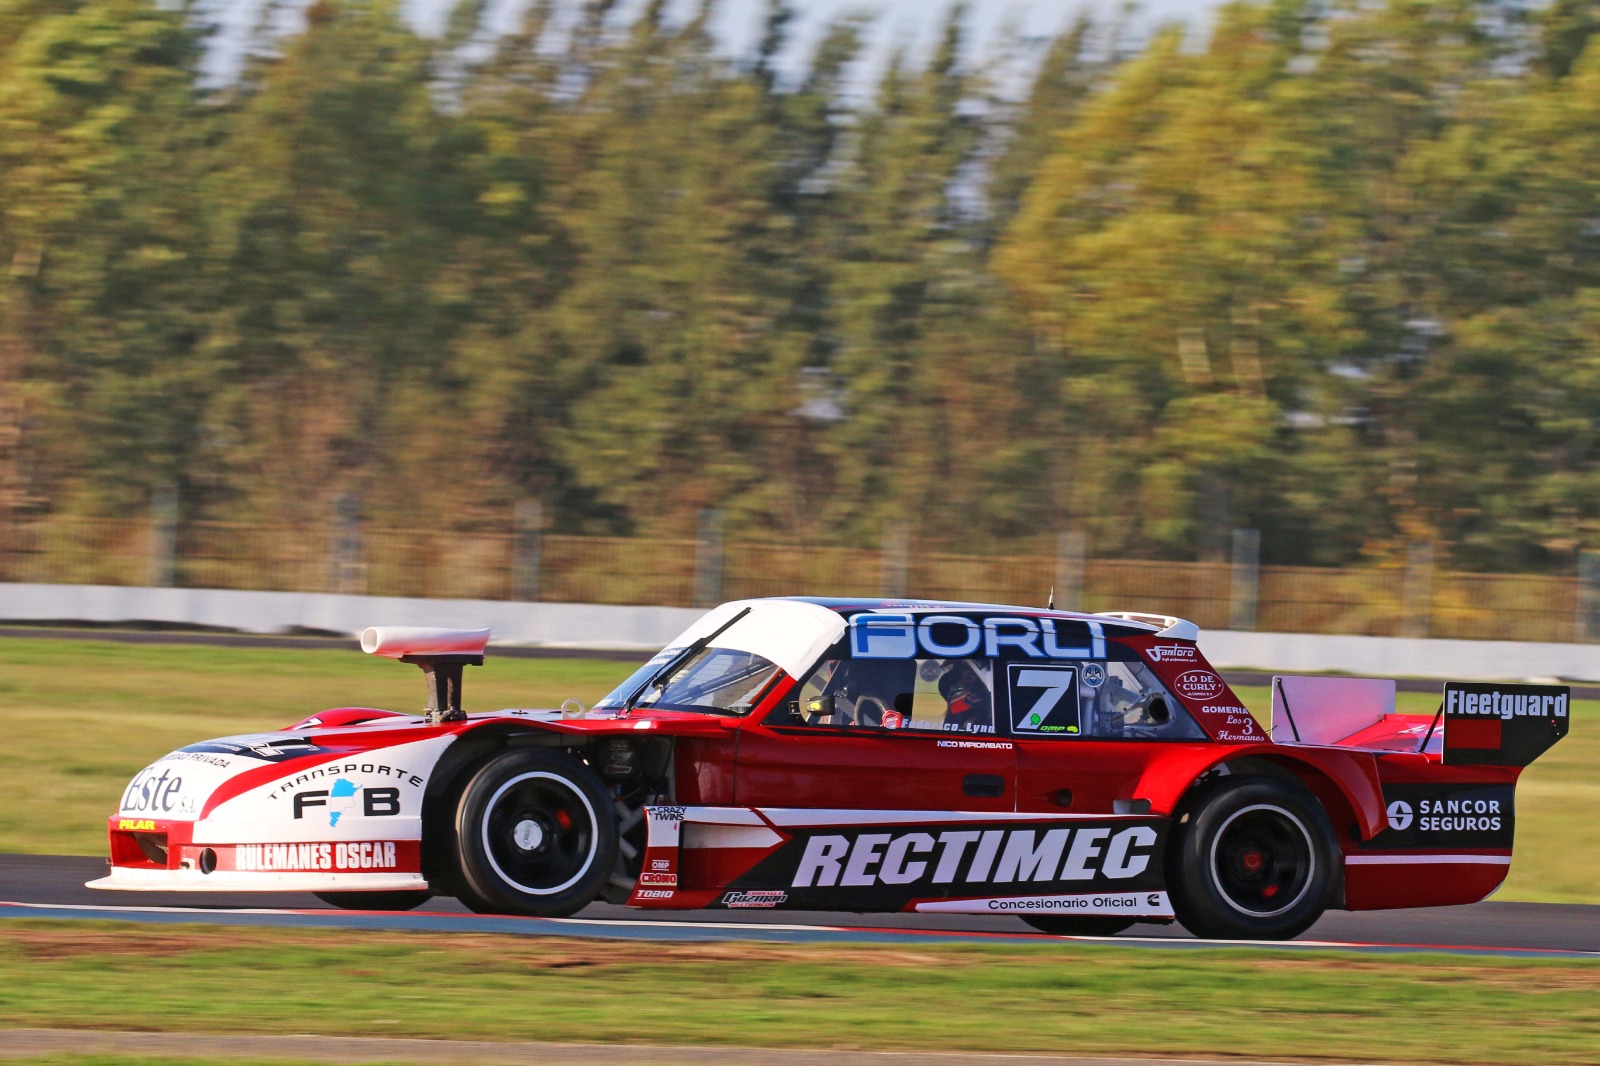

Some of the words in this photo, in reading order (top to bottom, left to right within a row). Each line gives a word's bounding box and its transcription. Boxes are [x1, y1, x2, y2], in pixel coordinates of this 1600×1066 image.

[849, 612, 1107, 660] FORLI
[1146, 643, 1196, 662] Santoro
[1183, 675, 1197, 683] LO
[1200, 675, 1215, 683] DE
[1183, 683, 1216, 691] CURLY
[1016, 669, 1073, 729] 7
[1446, 689, 1568, 720] Fleetguard
[1202, 706, 1249, 715] GOMERIA
[1226, 714, 1242, 724] Los
[1242, 717, 1253, 735] 3
[1216, 730, 1265, 741] Hermanos
[191, 753, 230, 769] PRIVADA
[121, 766, 182, 813] Este
[267, 764, 424, 800] TRANSPORTE
[294, 790, 329, 819] F
[363, 787, 401, 816] B
[657, 806, 687, 814] CRAZY
[1420, 800, 1501, 814] SANCOR
[654, 813, 685, 821] TWINS
[1420, 817, 1502, 831] SEGUROS
[119, 820, 155, 830] PILAR
[235, 844, 332, 871] RULEMANES
[335, 841, 396, 869] OSCAR
[791, 826, 1158, 888] RECTIMEC
[637, 889, 674, 899] TOBIO
[988, 899, 1088, 910] Concesionario
[1092, 896, 1137, 907] Oficial
